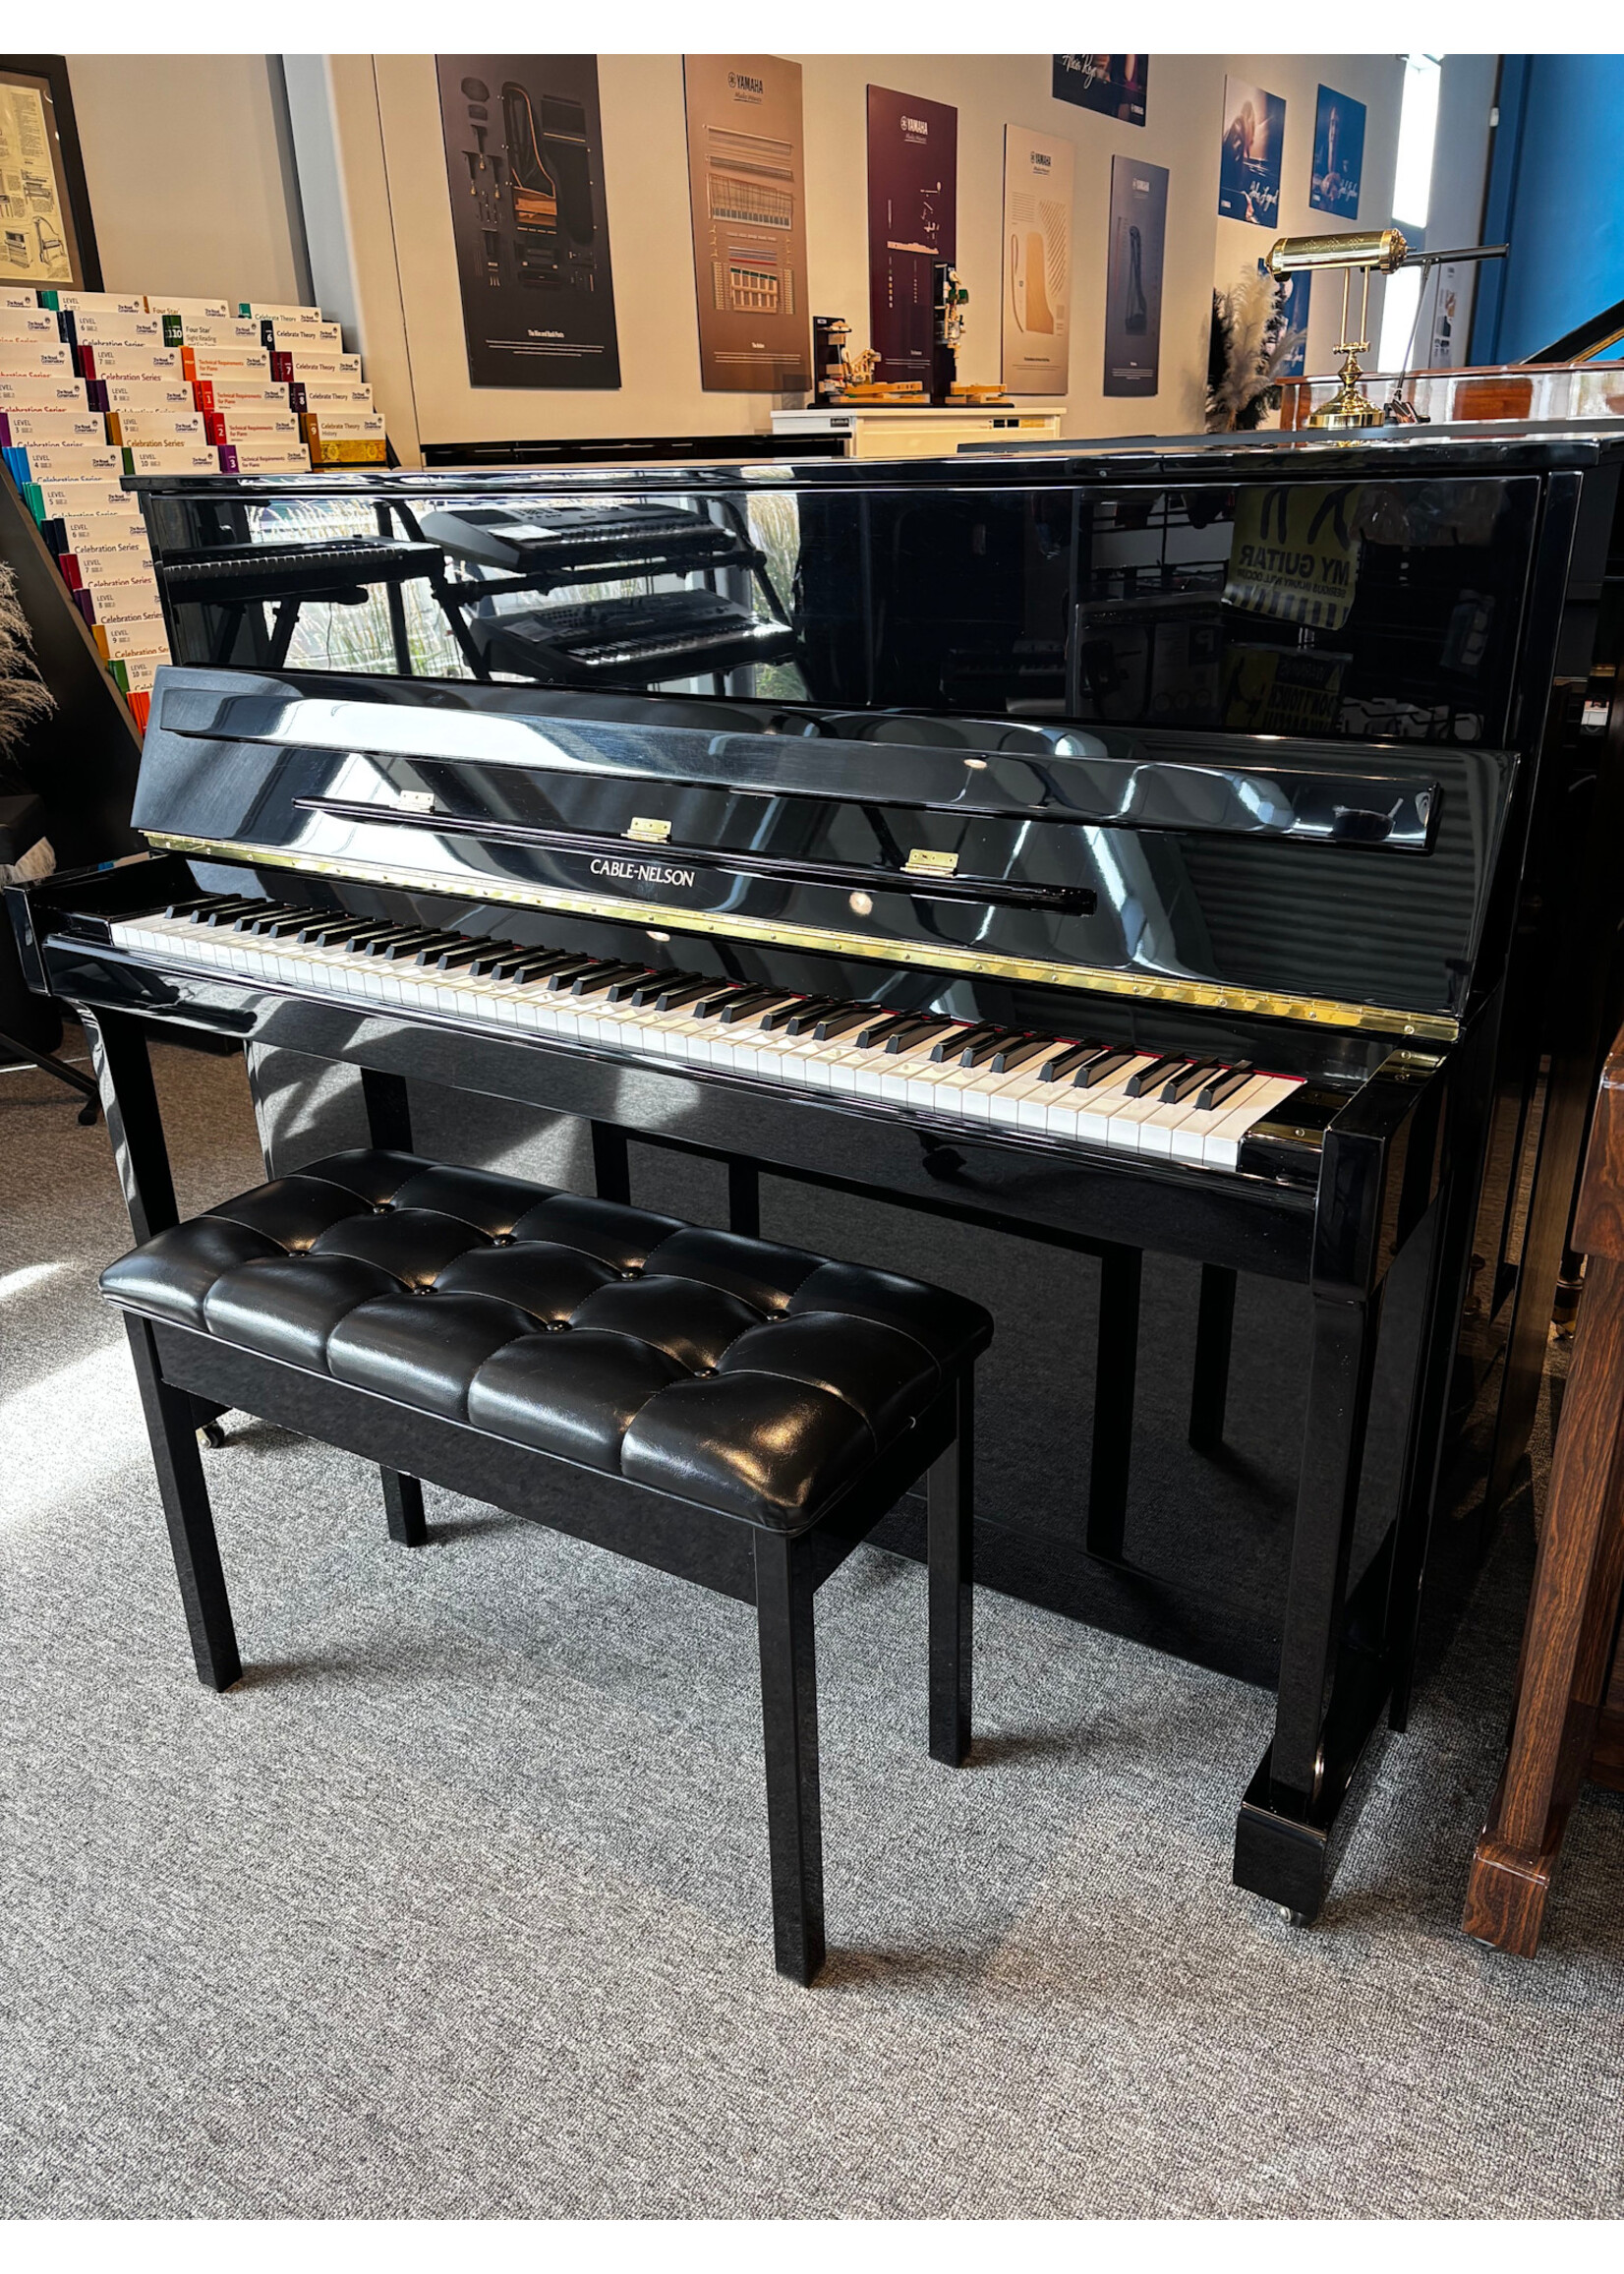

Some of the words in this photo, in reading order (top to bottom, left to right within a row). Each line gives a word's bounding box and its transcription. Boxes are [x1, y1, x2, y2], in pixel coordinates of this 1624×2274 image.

[737, 75, 764, 94] YAMAHA
[907, 117, 928, 136] YAMAHA
[101, 373, 140, 381] Celebration
[299, 396, 305, 405] 8
[230, 459, 236, 468] 3
[75, 545, 116, 554] Celebration
[101, 614, 143, 624] Celebration
[144, 612, 163, 620] Series
[115, 648, 156, 659] Celebration
[590, 858, 695, 887] CABLE-NELSON
